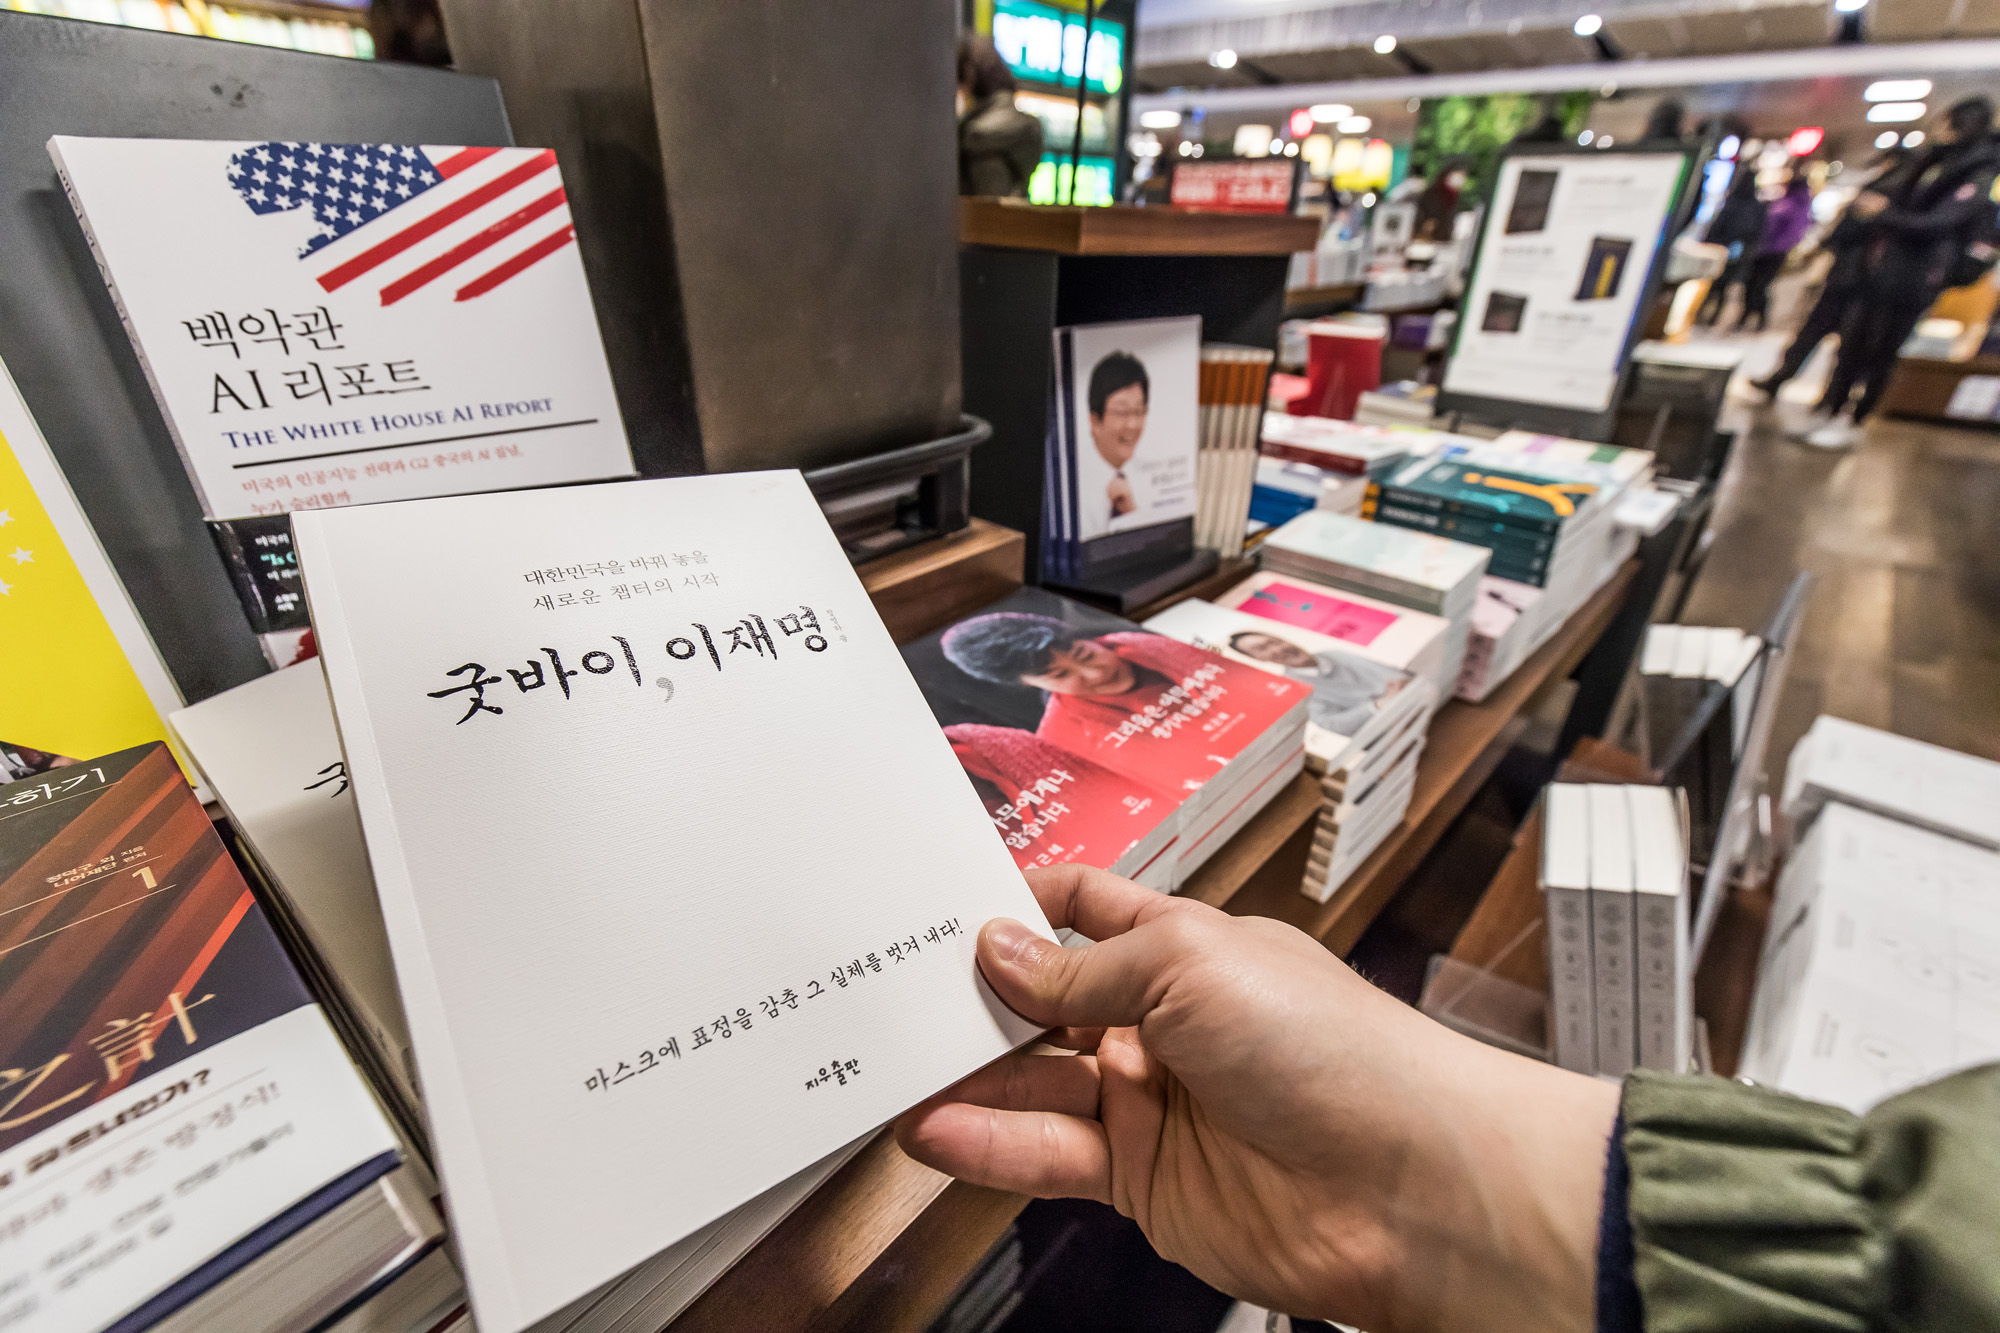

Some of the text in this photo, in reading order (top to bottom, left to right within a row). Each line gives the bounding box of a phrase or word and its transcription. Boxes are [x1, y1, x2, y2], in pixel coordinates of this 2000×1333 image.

[181, 305, 346, 360] 백악관
[208, 359, 432, 415] AI 리포트
[222, 397, 554, 449] THE WHITE HOUSE AI REPORT
[241, 474, 292, 494] 미국의
[295, 466, 358, 488] 인공지능
[409, 456, 430, 470] G2
[433, 449, 474, 467] 중국의
[523, 549, 710, 587] 대한민국을 바꿔 놓을
[533, 571, 720, 612] 새로운 챕터의 시작
[665, 605, 829, 672] 이재명
[0, 767, 106, 808] 하기
[53, 861, 118, 888] 니어재단
[131, 866, 158, 890] 1
[583, 917, 964, 1093] 마스크에 표정을 감춘 그 실체를 벗겨 내다!
[803, 1057, 862, 1091] 지우출판
